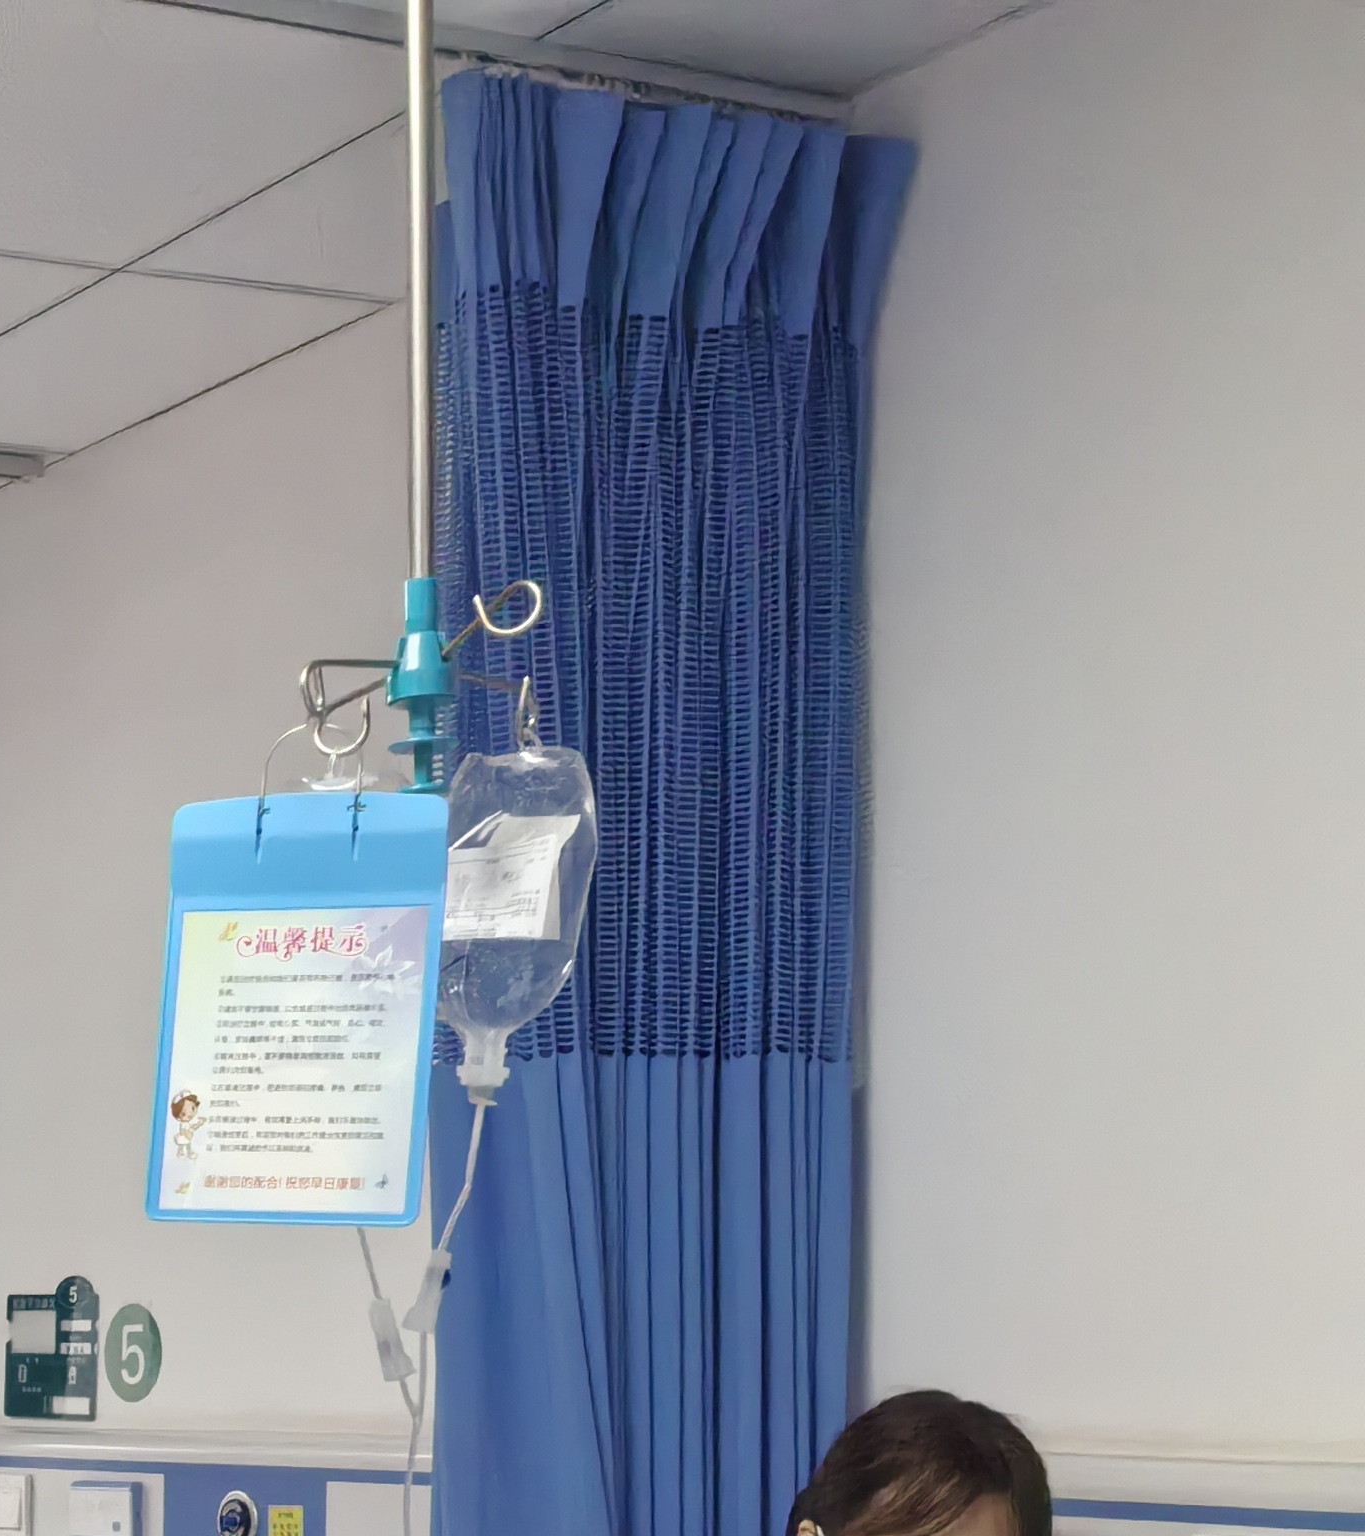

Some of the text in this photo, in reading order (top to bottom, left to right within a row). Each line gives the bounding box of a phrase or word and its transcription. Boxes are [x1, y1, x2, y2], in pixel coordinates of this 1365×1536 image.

[254, 923, 368, 961] 温馨提示
[69, 1286, 78, 1303] 5
[121, 1324, 145, 1385] 5
